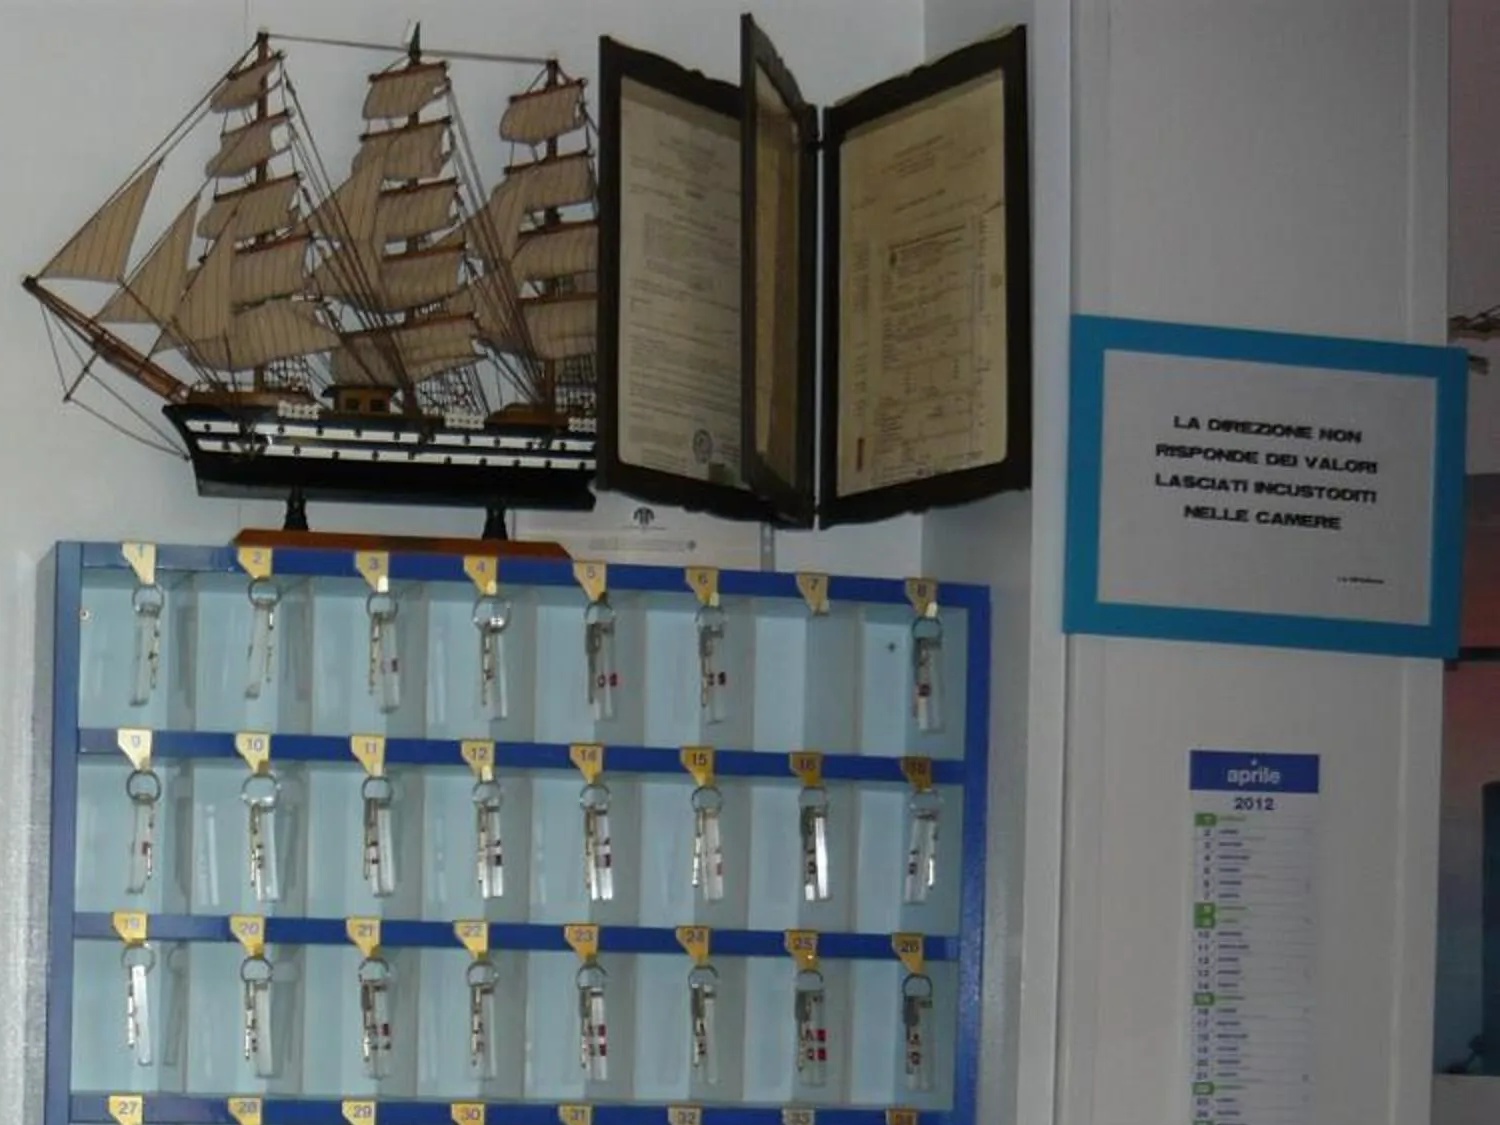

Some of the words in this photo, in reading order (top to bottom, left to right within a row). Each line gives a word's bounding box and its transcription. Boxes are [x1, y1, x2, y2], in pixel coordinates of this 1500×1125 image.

[1173, 415, 1201, 431] LA
[1207, 418, 1313, 440] DIREZIONE
[1318, 427, 1362, 444] NON
[1155, 443, 1259, 465] RISPONDE
[1265, 452, 1298, 467] DEI
[1305, 456, 1378, 474] VALORI
[1155, 474, 1249, 494] LASCIATI
[1253, 480, 1377, 504] INCUSTODITI
[1183, 504, 1249, 524] NELLE
[1255, 510, 1342, 531] CAMERE
[246, 738, 264, 752] 10
[1226, 766, 1281, 787] aprile
[1233, 796, 1275, 812] 2012
[118, 1100, 138, 1116] 27
